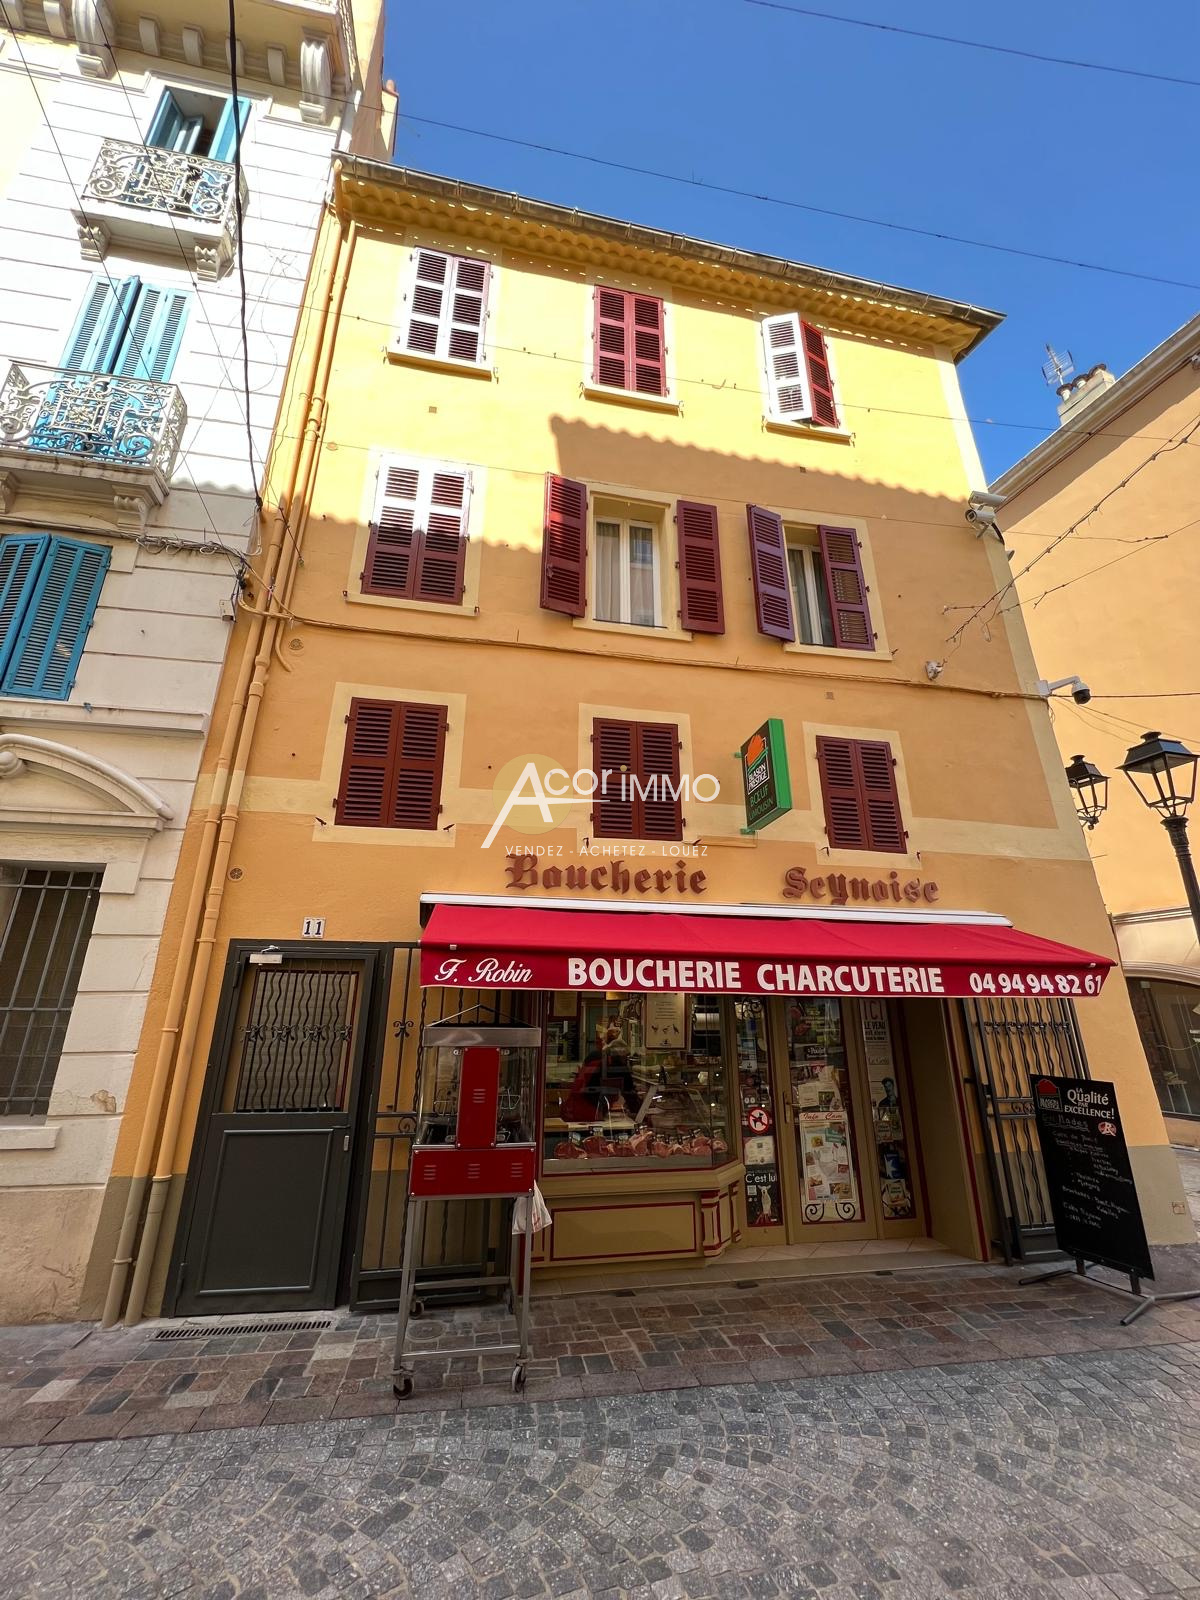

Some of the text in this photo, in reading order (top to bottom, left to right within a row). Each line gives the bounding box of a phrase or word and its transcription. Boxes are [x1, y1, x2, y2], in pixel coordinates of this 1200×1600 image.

[505, 854, 708, 895] Boucherie
[782, 866, 939, 905] Seynoise
[303, 920, 323, 937] 11
[468, 958, 533, 983] Robin
[568, 957, 742, 989] BOUCHERIE
[757, 963, 945, 994] CHARCUTERIE
[969, 972, 996, 994] 04
[998, 973, 1023, 995] 94
[1026, 974, 1054, 995] 94
[1056, 974, 1082, 995] 82
[1084, 974, 1102, 995] 61
[863, 1000, 884, 1020] ICI
[1066, 1088, 1109, 1106] Qualité
[745, 1172, 767, 1183] C'est
